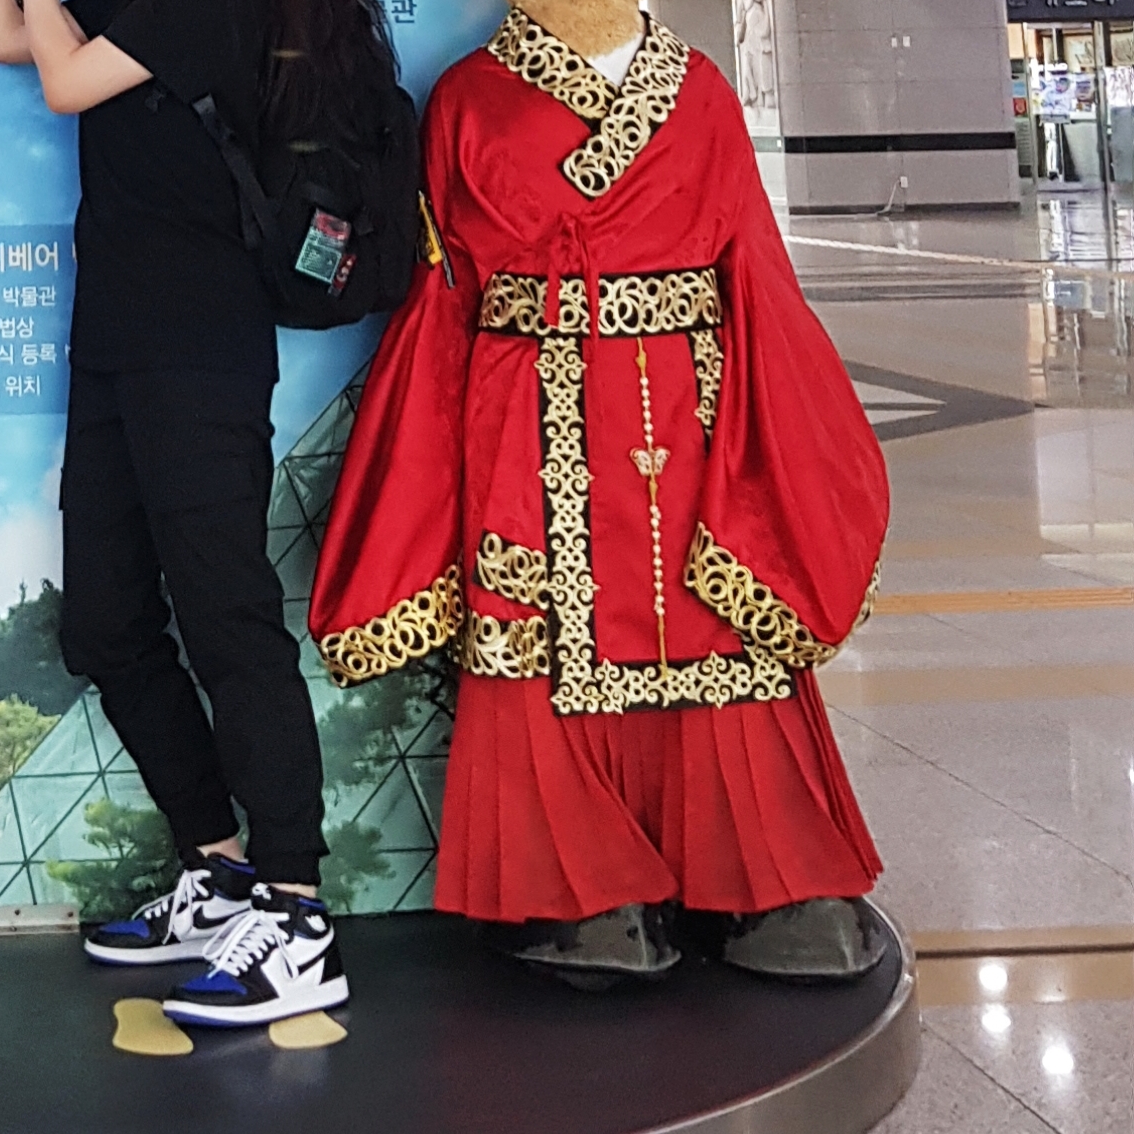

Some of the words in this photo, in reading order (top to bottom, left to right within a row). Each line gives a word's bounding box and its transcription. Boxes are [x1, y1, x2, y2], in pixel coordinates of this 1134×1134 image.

[3, 285, 56, 308] 박물관
[21, 342, 57, 366] 등록
[5, 374, 42, 397] 위치
